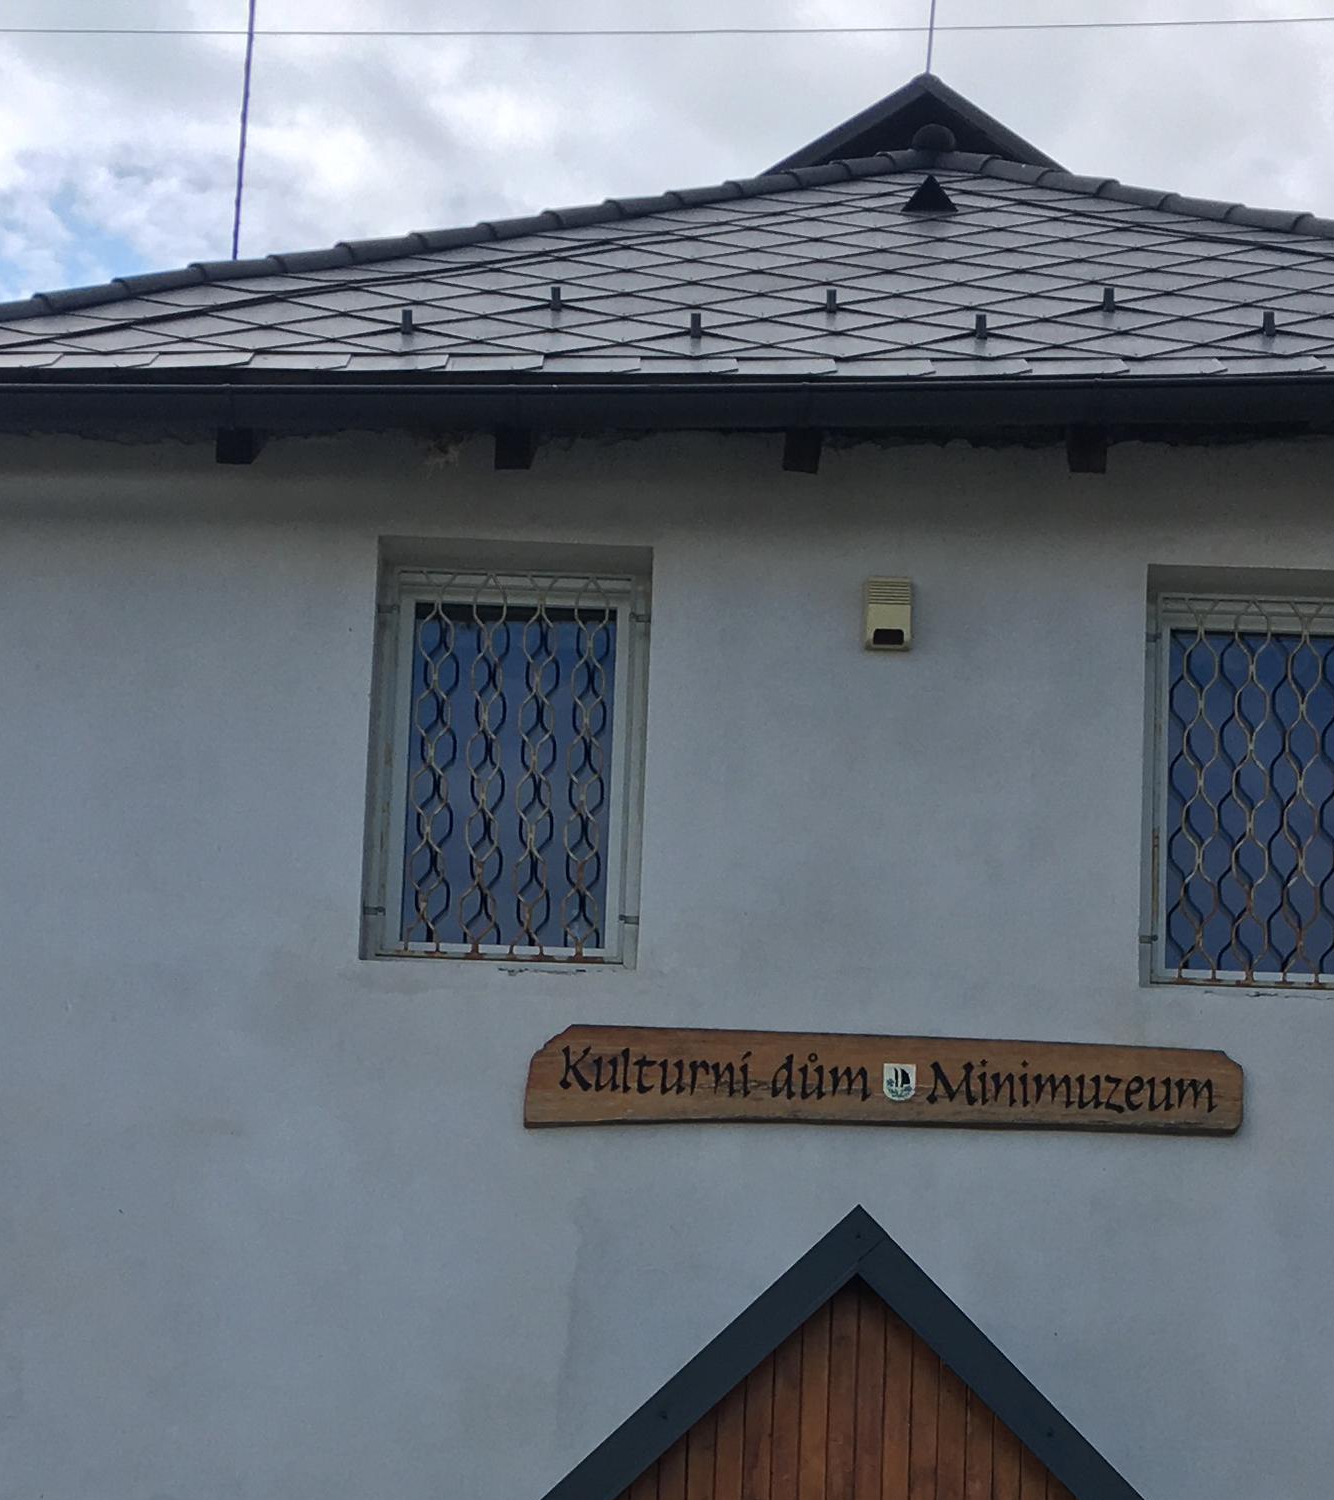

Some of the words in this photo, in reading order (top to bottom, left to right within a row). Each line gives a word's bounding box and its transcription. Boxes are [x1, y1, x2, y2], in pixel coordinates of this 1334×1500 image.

[559, 1045, 752, 1098] Kulturní
[770, 1052, 872, 1102] dům
[926, 1058, 1218, 1114] Minimuzeum
